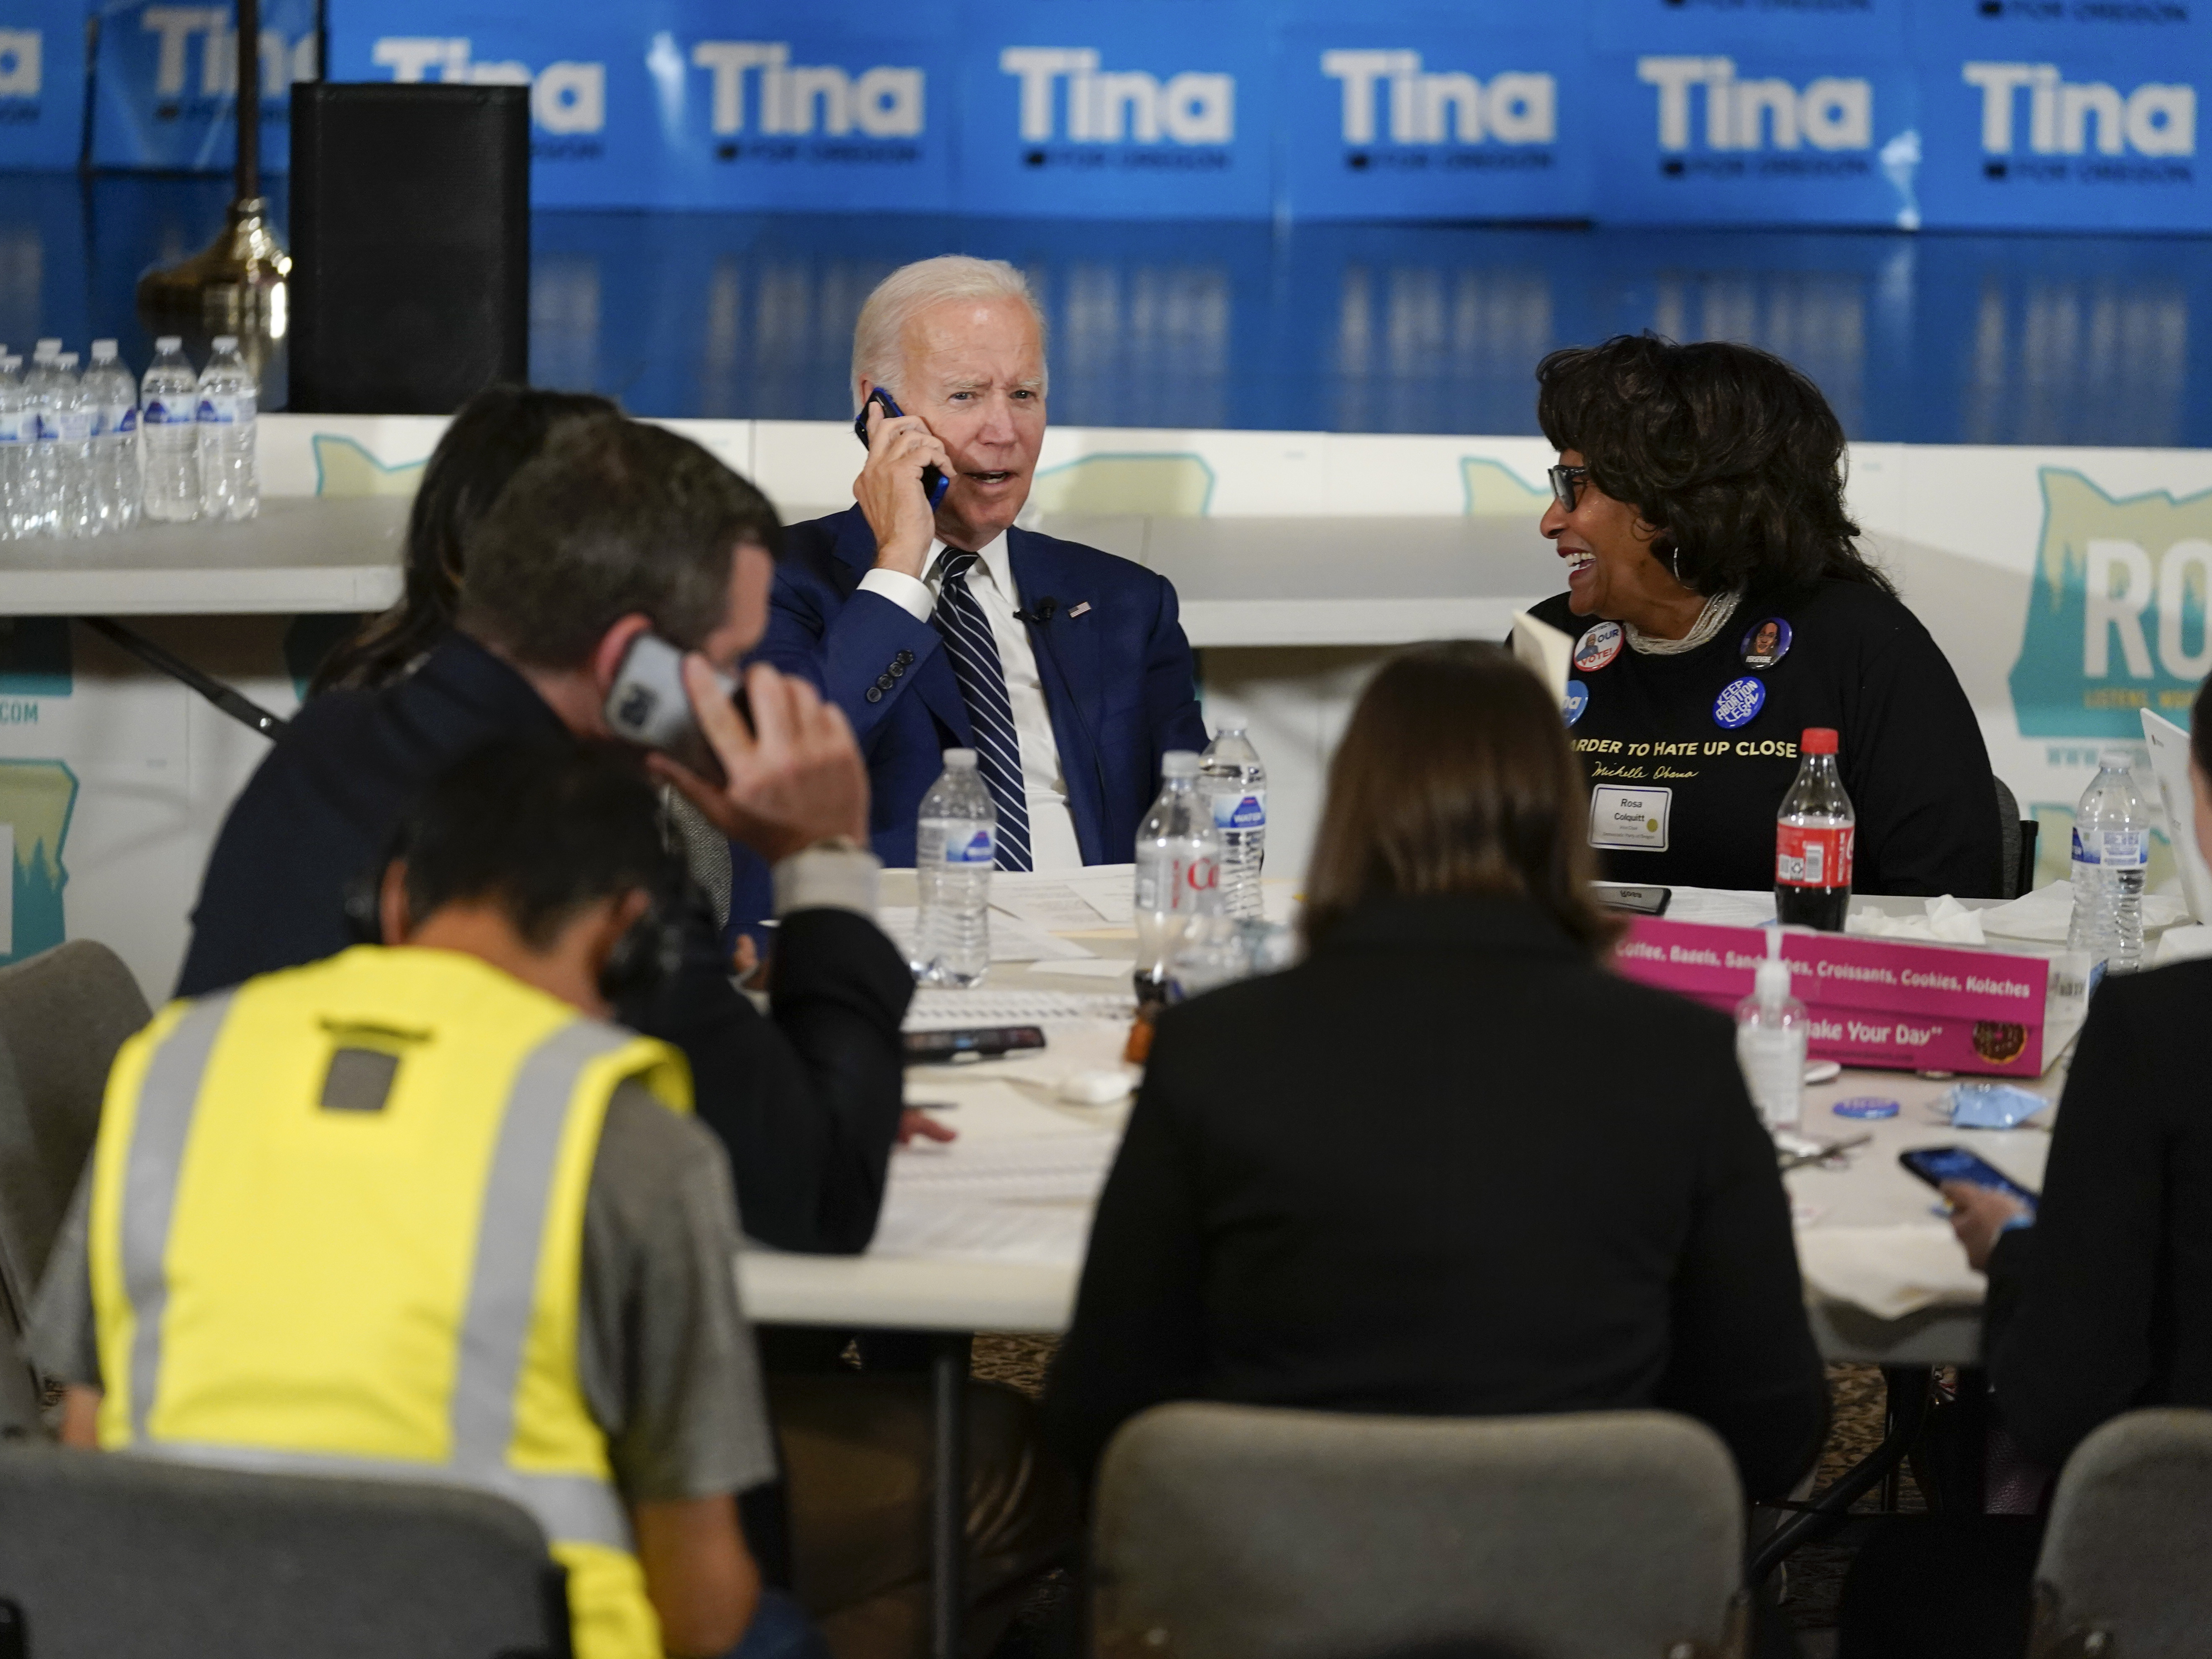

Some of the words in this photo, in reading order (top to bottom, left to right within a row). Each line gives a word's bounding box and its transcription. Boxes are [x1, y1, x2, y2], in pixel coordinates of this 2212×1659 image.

[692, 42, 924, 136] Tina
[999, 46, 1235, 143] Tina
[1320, 48, 1556, 144] Tina
[1637, 56, 1872, 150] Tina
[1962, 61, 2196, 157] Tina
[1598, 629, 1619, 643] OUR
[1581, 648, 1613, 666] VOTE!
[1715, 680, 1759, 721] ABORTION
[1716, 680, 1744, 706] KEEP
[1724, 692, 1759, 722] LEGAL
[1571, 739, 1623, 754] ARDER
[1627, 743, 1651, 756] TO
[1653, 741, 1699, 756] HATE
[1703, 741, 1730, 756] UP
[1735, 740, 1797, 758] CLOSE
[1591, 761, 1649, 778] Michelle
[1653, 766, 1700, 780] Obama
[1620, 798, 1643, 808] Rosa
[1614, 812, 1645, 823] Colquitt
[1816, 959, 1897, 985] Croissants,
[1901, 969, 1962, 991] Cookies,
[1965, 975, 2031, 998] Kolaches
[1847, 1020, 1892, 1044] Your
